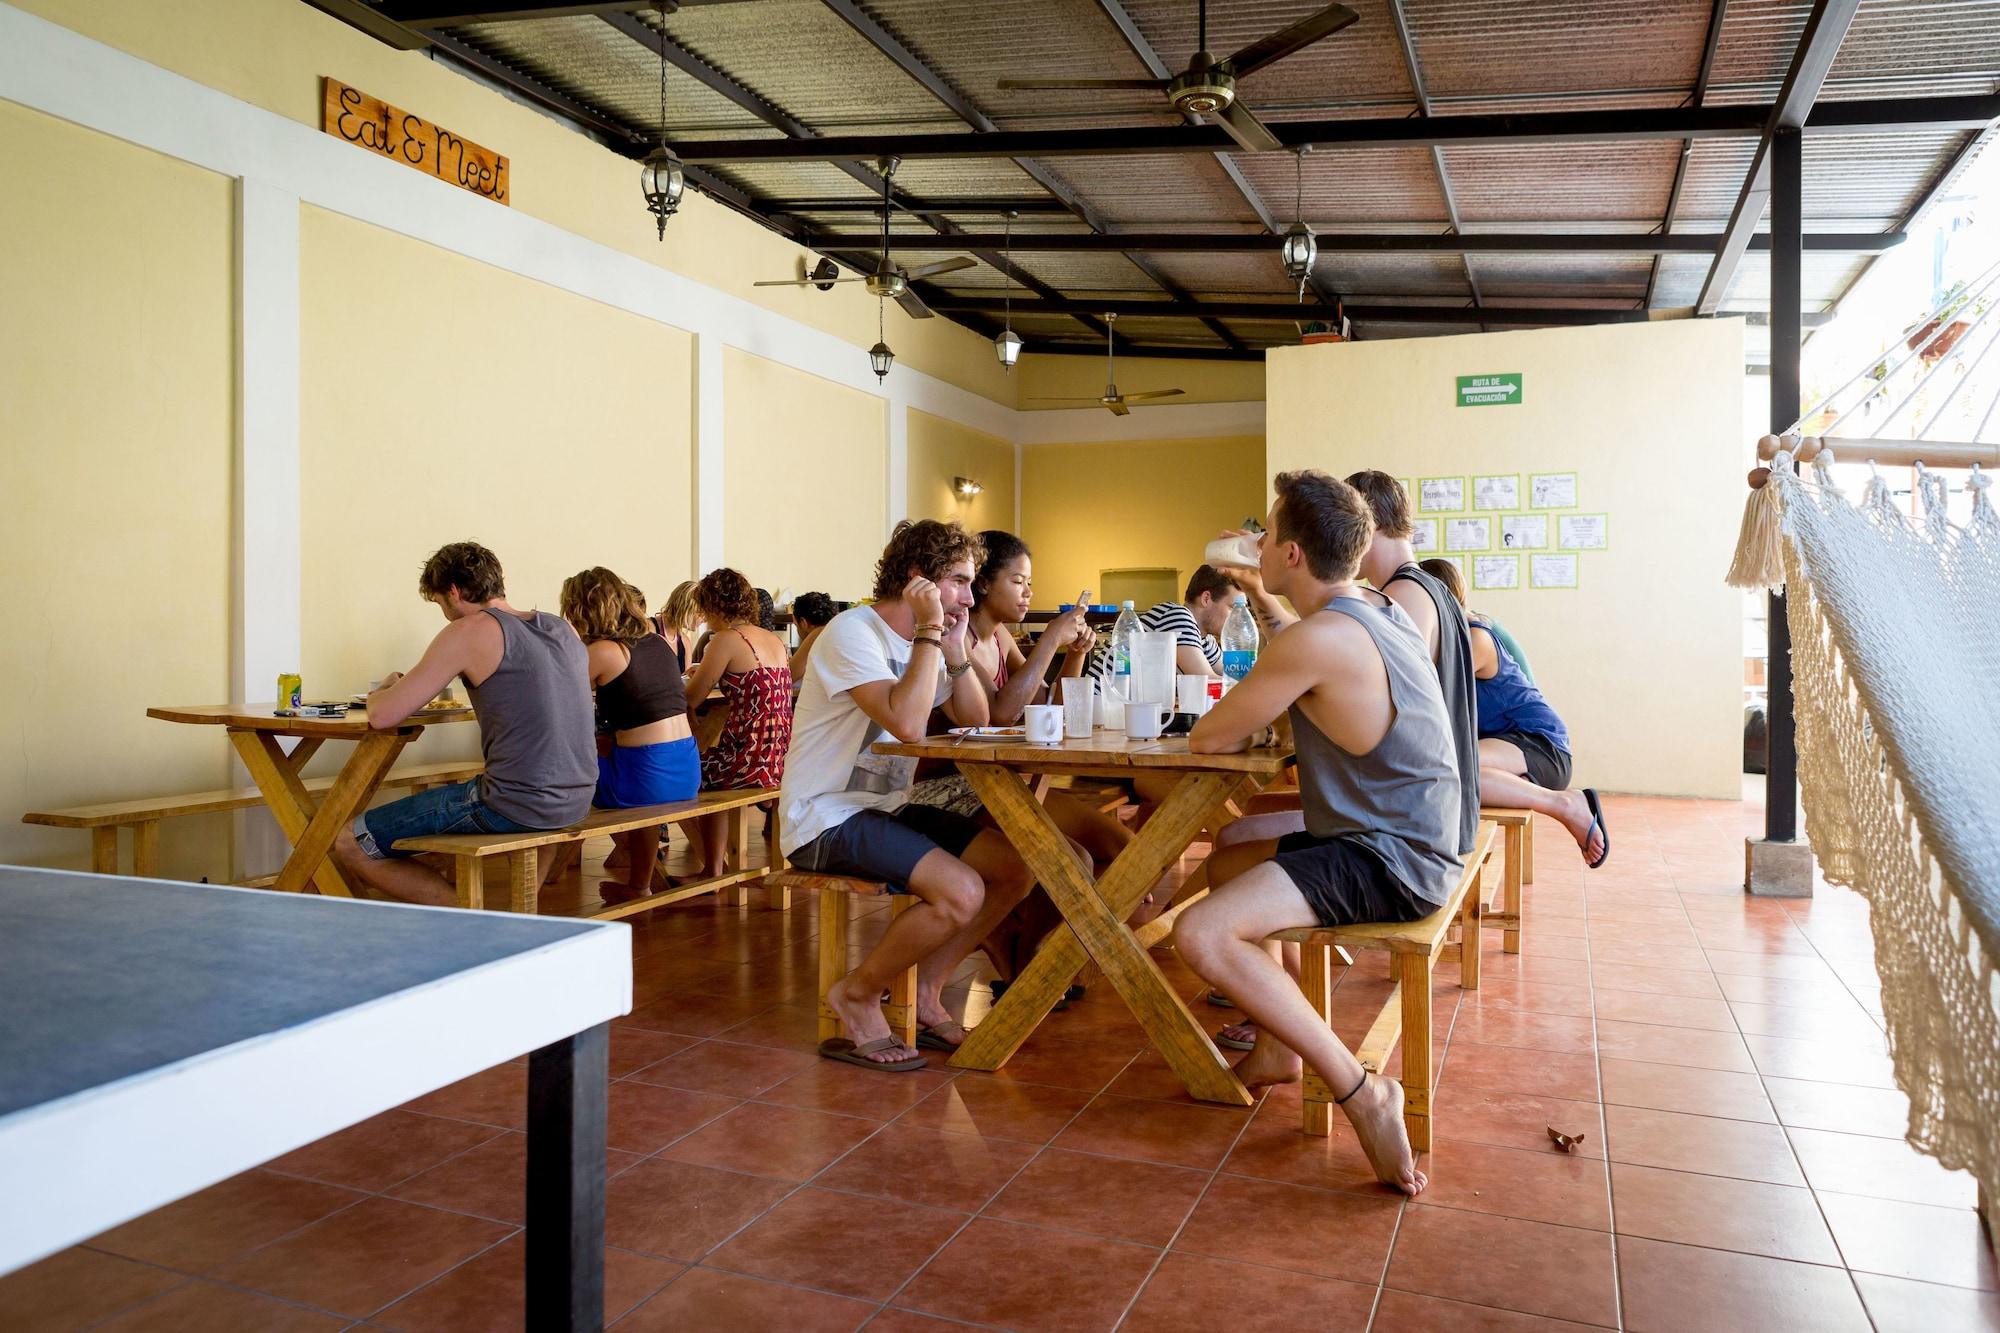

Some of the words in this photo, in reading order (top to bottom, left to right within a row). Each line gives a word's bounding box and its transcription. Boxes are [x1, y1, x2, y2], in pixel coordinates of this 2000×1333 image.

[338, 87, 396, 154] Eat
[403, 115, 425, 163] &
[434, 126, 504, 199] Meet
[1472, 378, 1490, 387] RUTA
[1491, 377, 1500, 386] DE
[1466, 392, 1507, 403] EVACUACIÓN
[1225, 664, 1249, 672] AQUA
